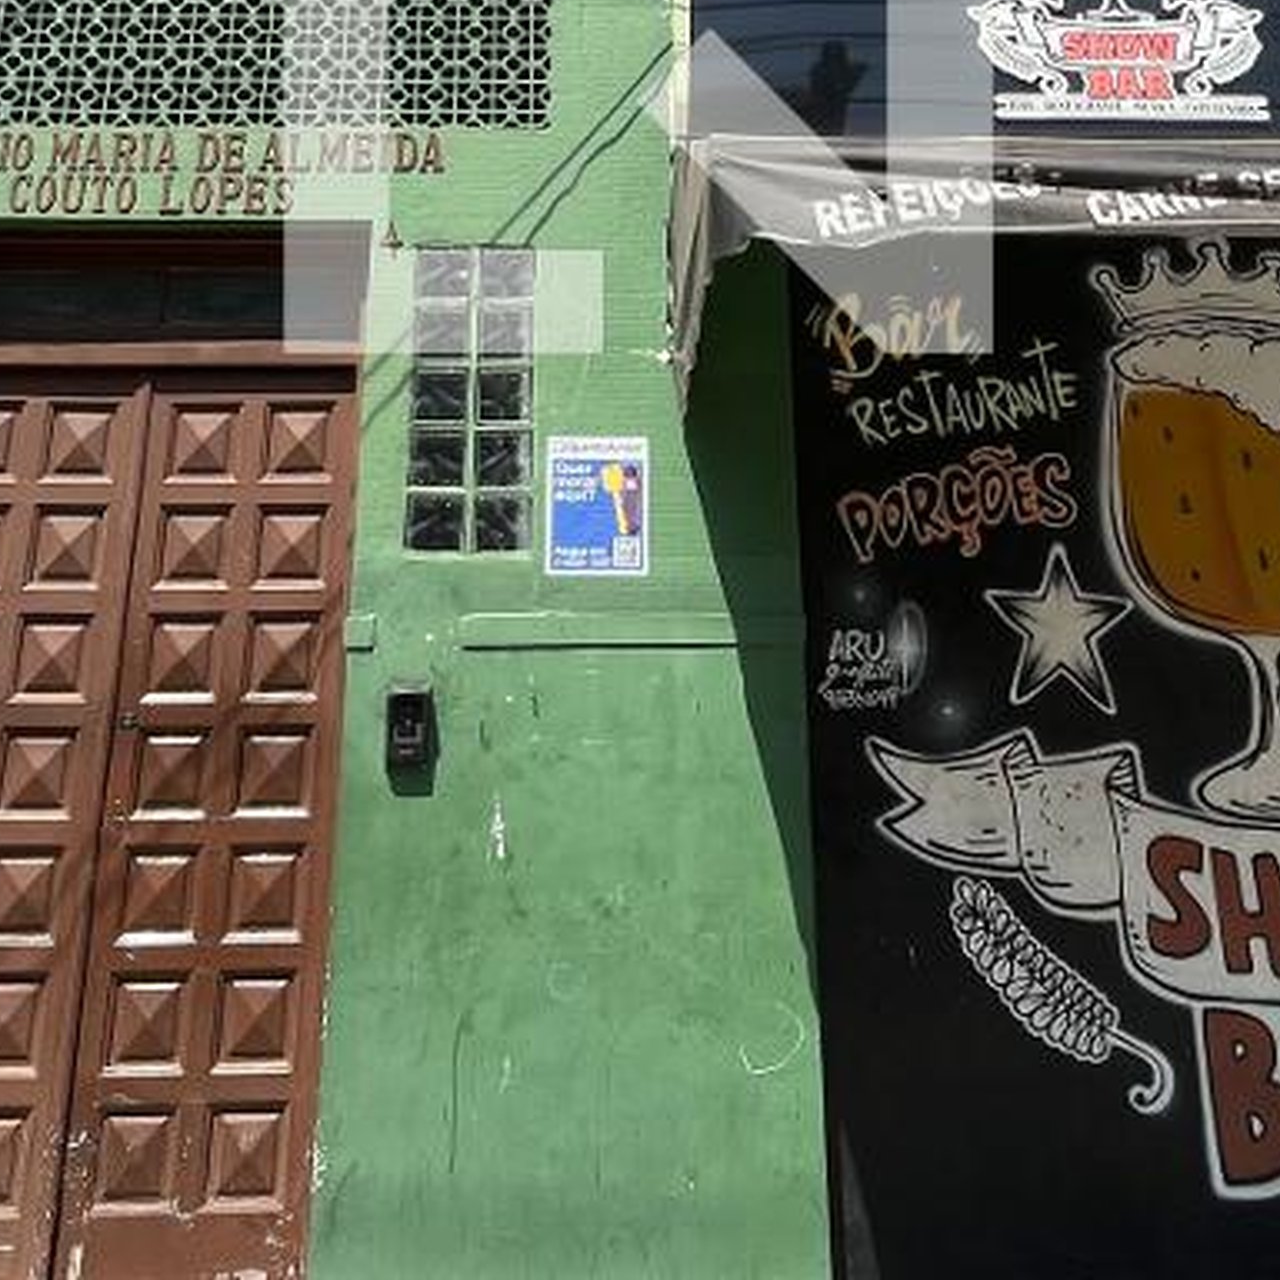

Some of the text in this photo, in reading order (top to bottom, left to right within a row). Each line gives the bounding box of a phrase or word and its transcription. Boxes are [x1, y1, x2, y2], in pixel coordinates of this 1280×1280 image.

[1061, 31, 1177, 60] SHOW
[1086, 66, 1173, 101] BAR
[48, 132, 183, 174] MARIA
[195, 132, 248, 174] DE
[259, 131, 447, 175] ALMEIDA
[7, 175, 296, 215] COUTO LOPES
[849, 334, 1079, 447] RESTAURANTE
[835, 443, 1079, 564] PORÇÕES
